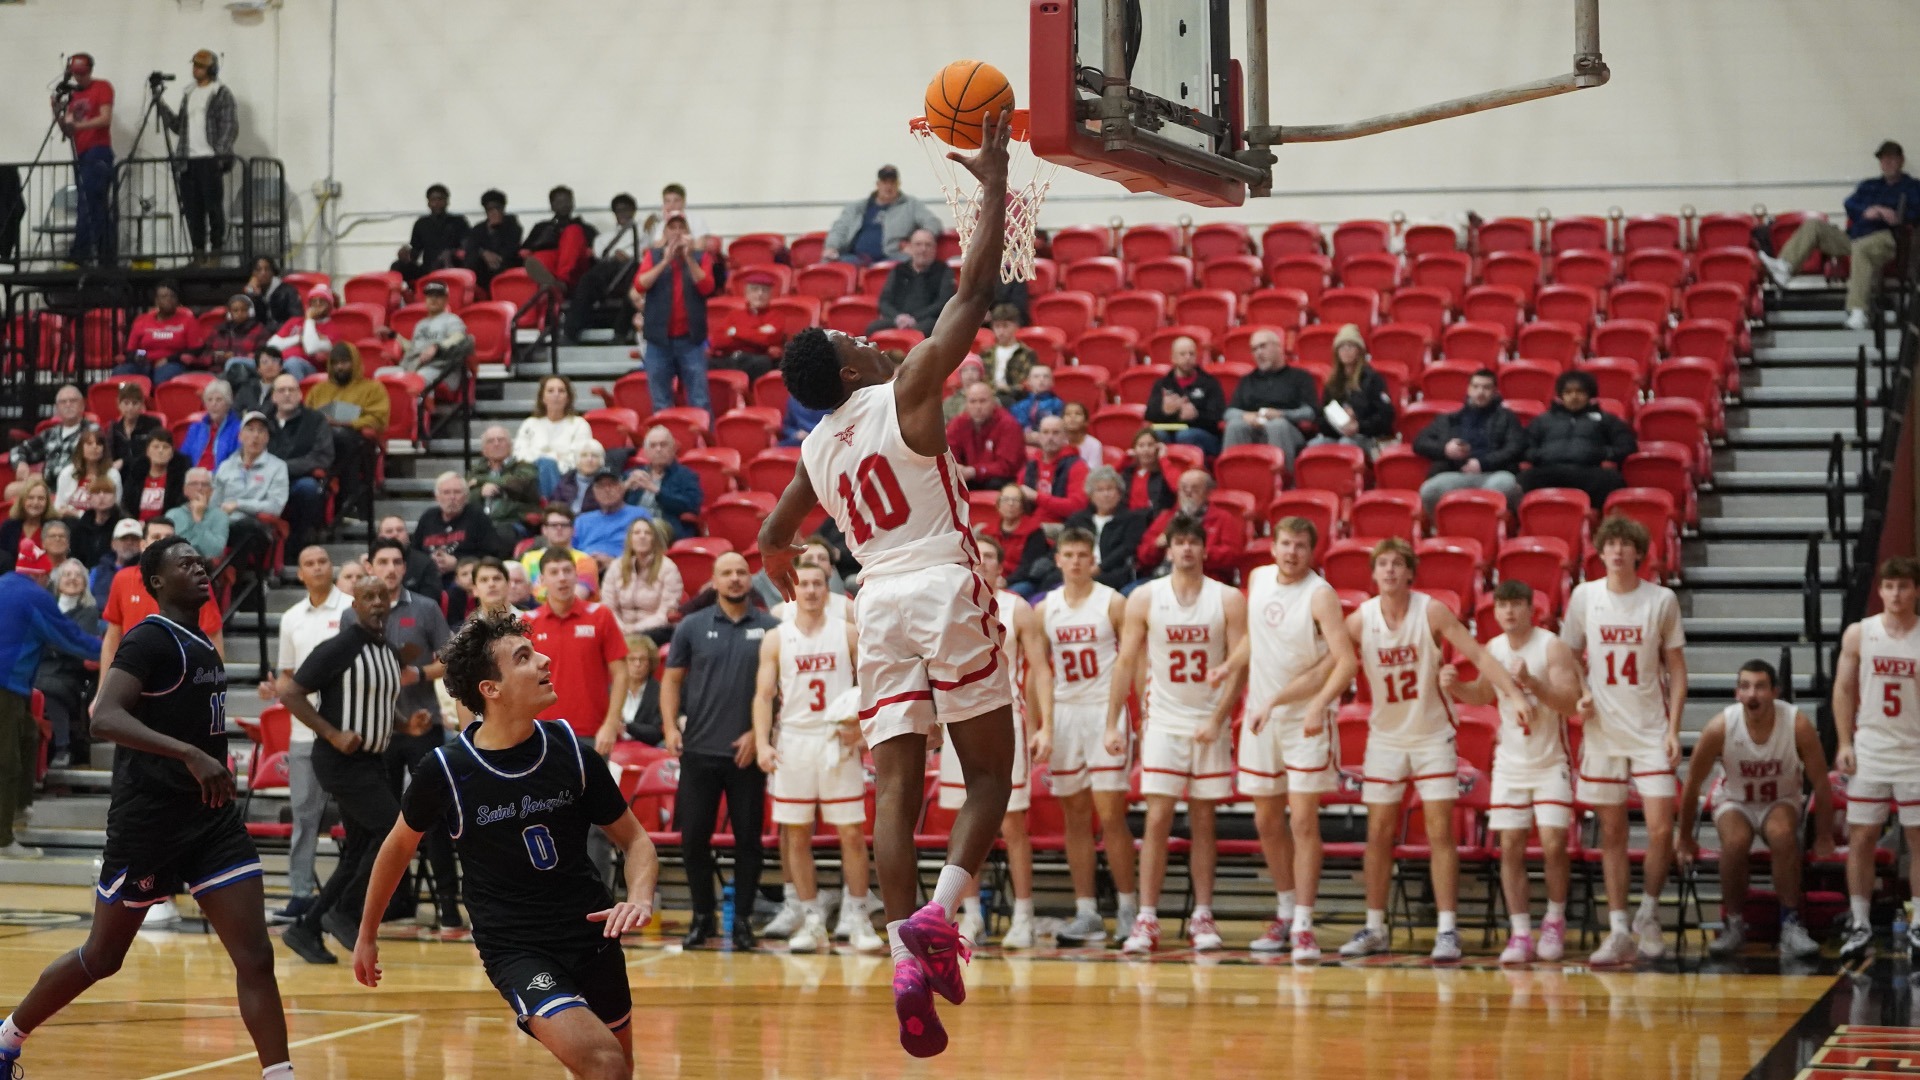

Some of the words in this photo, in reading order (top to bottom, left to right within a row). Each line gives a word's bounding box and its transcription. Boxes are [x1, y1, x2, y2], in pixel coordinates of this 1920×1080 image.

[837, 451, 911, 545] 10
[1055, 624, 1098, 644] WPI
[1165, 624, 1210, 644] WPI
[1600, 625, 1642, 645] WPI
[795, 653, 836, 674] WPI
[1062, 648, 1098, 682] 20
[1169, 650, 1207, 683] 23
[1377, 644, 1418, 667] WPI
[1605, 651, 1638, 685] 14
[1873, 656, 1916, 678] WPI
[809, 679, 826, 712] 3
[1384, 671, 1418, 702] 12
[1883, 682, 1901, 717] 5
[476, 803, 517, 825] Saint
[522, 824, 558, 870] 0
